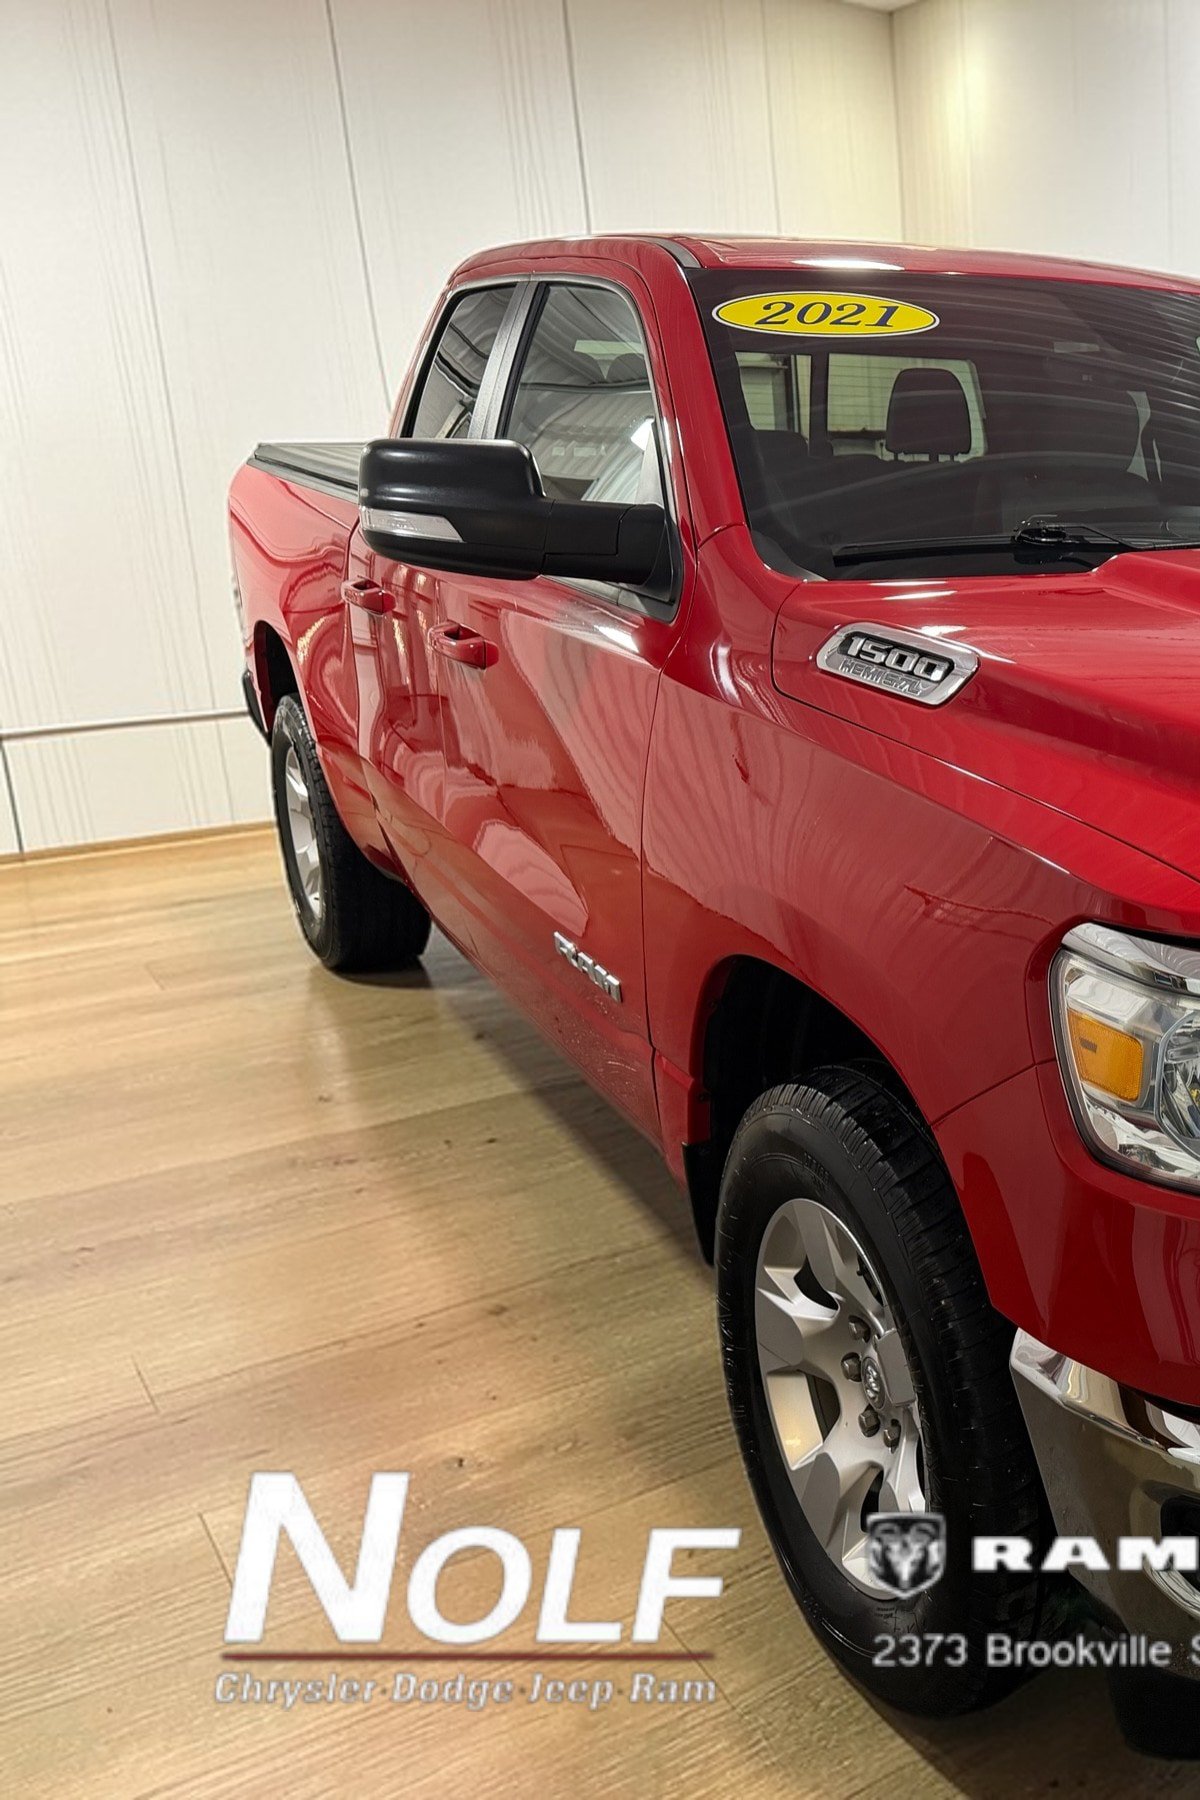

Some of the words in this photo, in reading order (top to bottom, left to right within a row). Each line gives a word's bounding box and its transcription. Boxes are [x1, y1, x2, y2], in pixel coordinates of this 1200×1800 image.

[754, 301, 900, 328] 2021
[839, 658, 881, 683] HEMI
[846, 636, 950, 682] 1500
